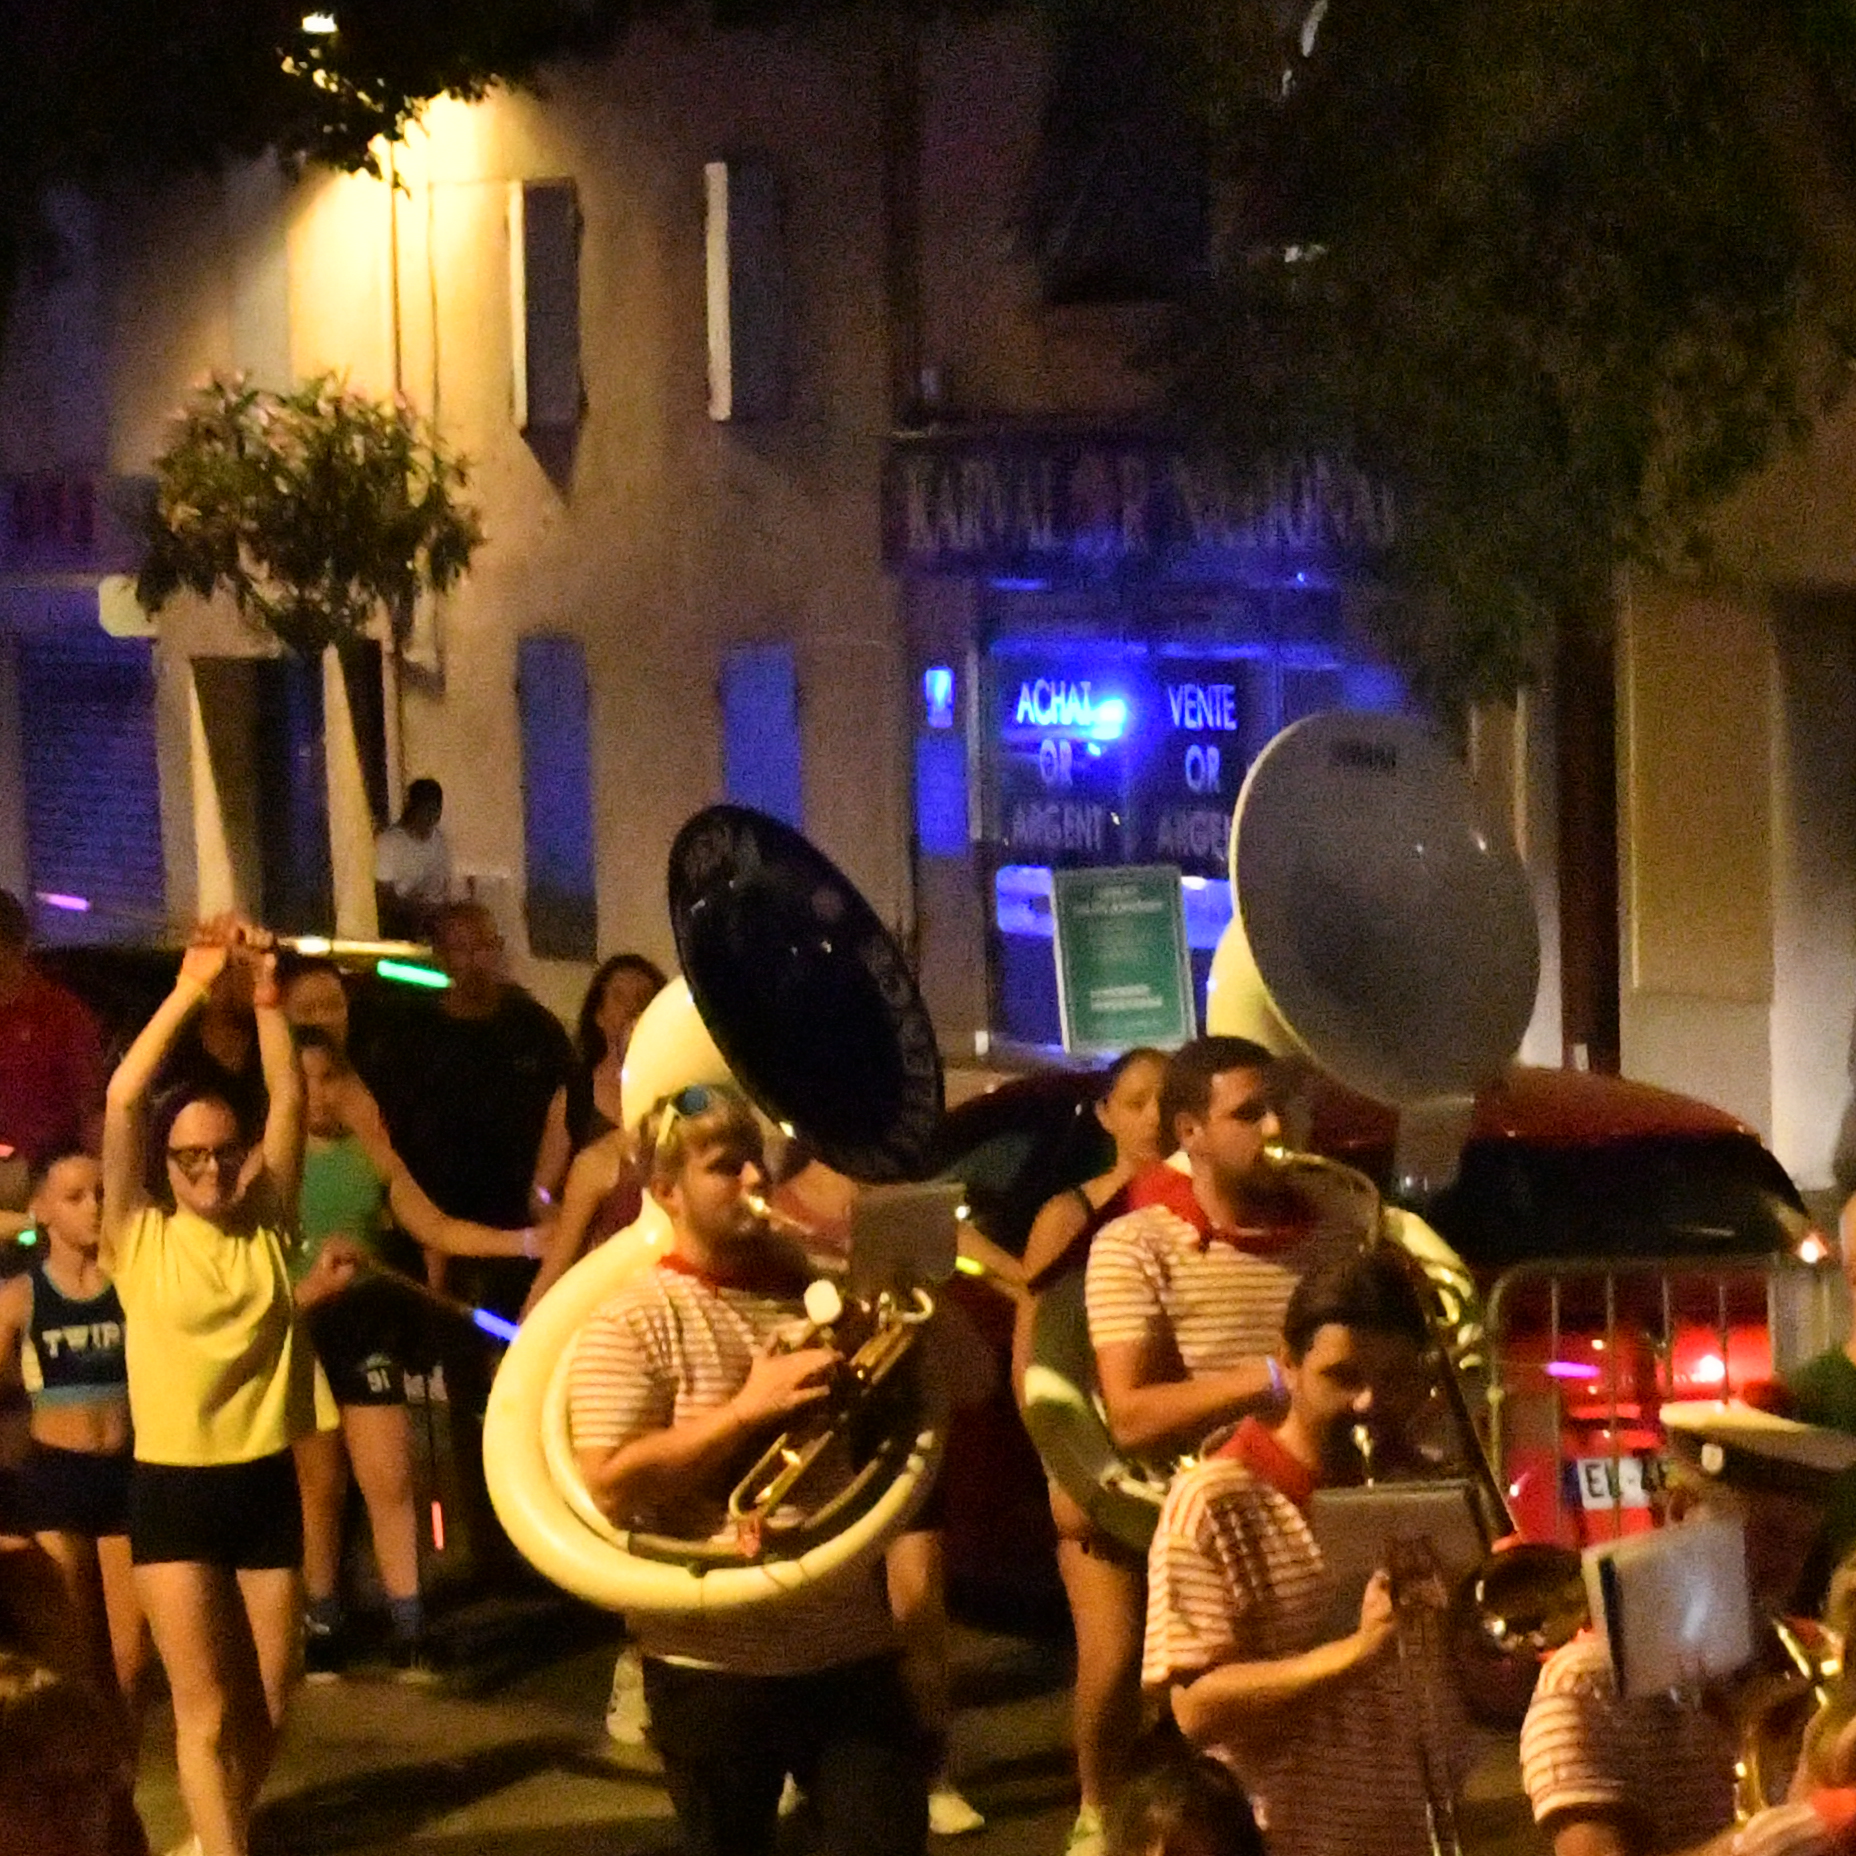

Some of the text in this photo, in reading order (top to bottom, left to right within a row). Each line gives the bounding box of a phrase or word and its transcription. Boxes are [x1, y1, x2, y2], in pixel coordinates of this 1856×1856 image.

[1016, 678, 1093, 726] ACHAT
[1167, 683, 1238, 731] VENTE
[1039, 738, 1074, 788] OR
[1185, 744, 1221, 794] OR
